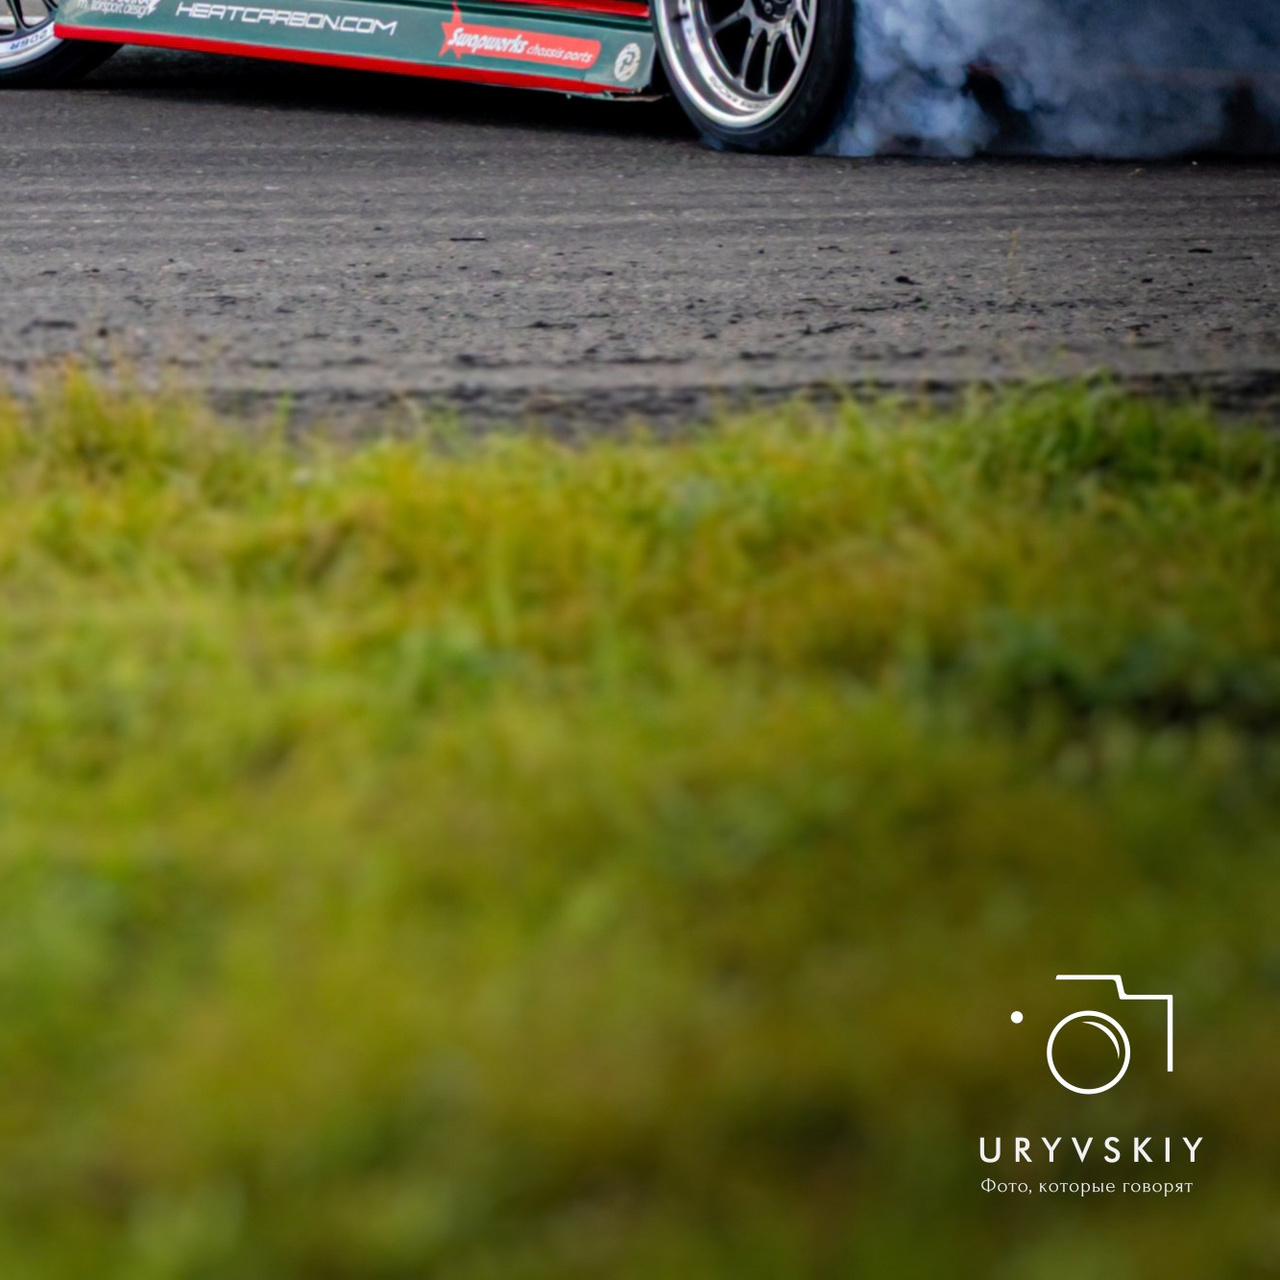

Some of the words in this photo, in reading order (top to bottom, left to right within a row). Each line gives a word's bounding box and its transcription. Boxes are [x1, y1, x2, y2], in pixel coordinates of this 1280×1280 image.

[175, 1, 398, 36] HEATCARBON.COM
[447, 27, 529, 54] Swapworks
[526, 43, 566, 59] chassis
[563, 48, 594, 64] parts
